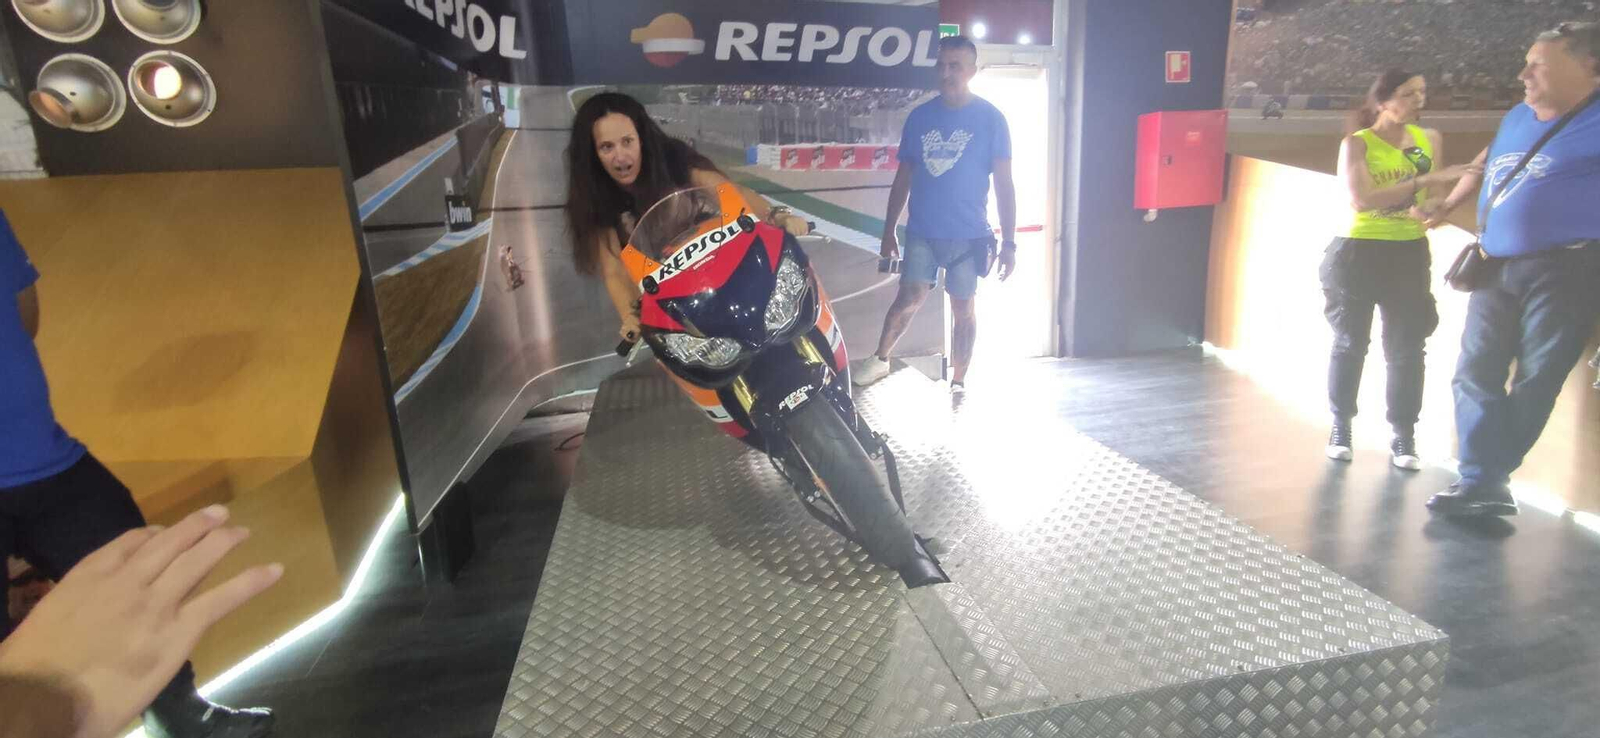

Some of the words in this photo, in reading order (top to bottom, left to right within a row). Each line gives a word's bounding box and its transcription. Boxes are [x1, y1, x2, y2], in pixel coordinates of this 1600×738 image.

[404, 0, 528, 59] PSOL
[715, 21, 938, 67] REPSOL
[448, 200, 472, 224] bwin
[659, 225, 740, 281] REPSOL
[778, 384, 815, 411] REPSOL
